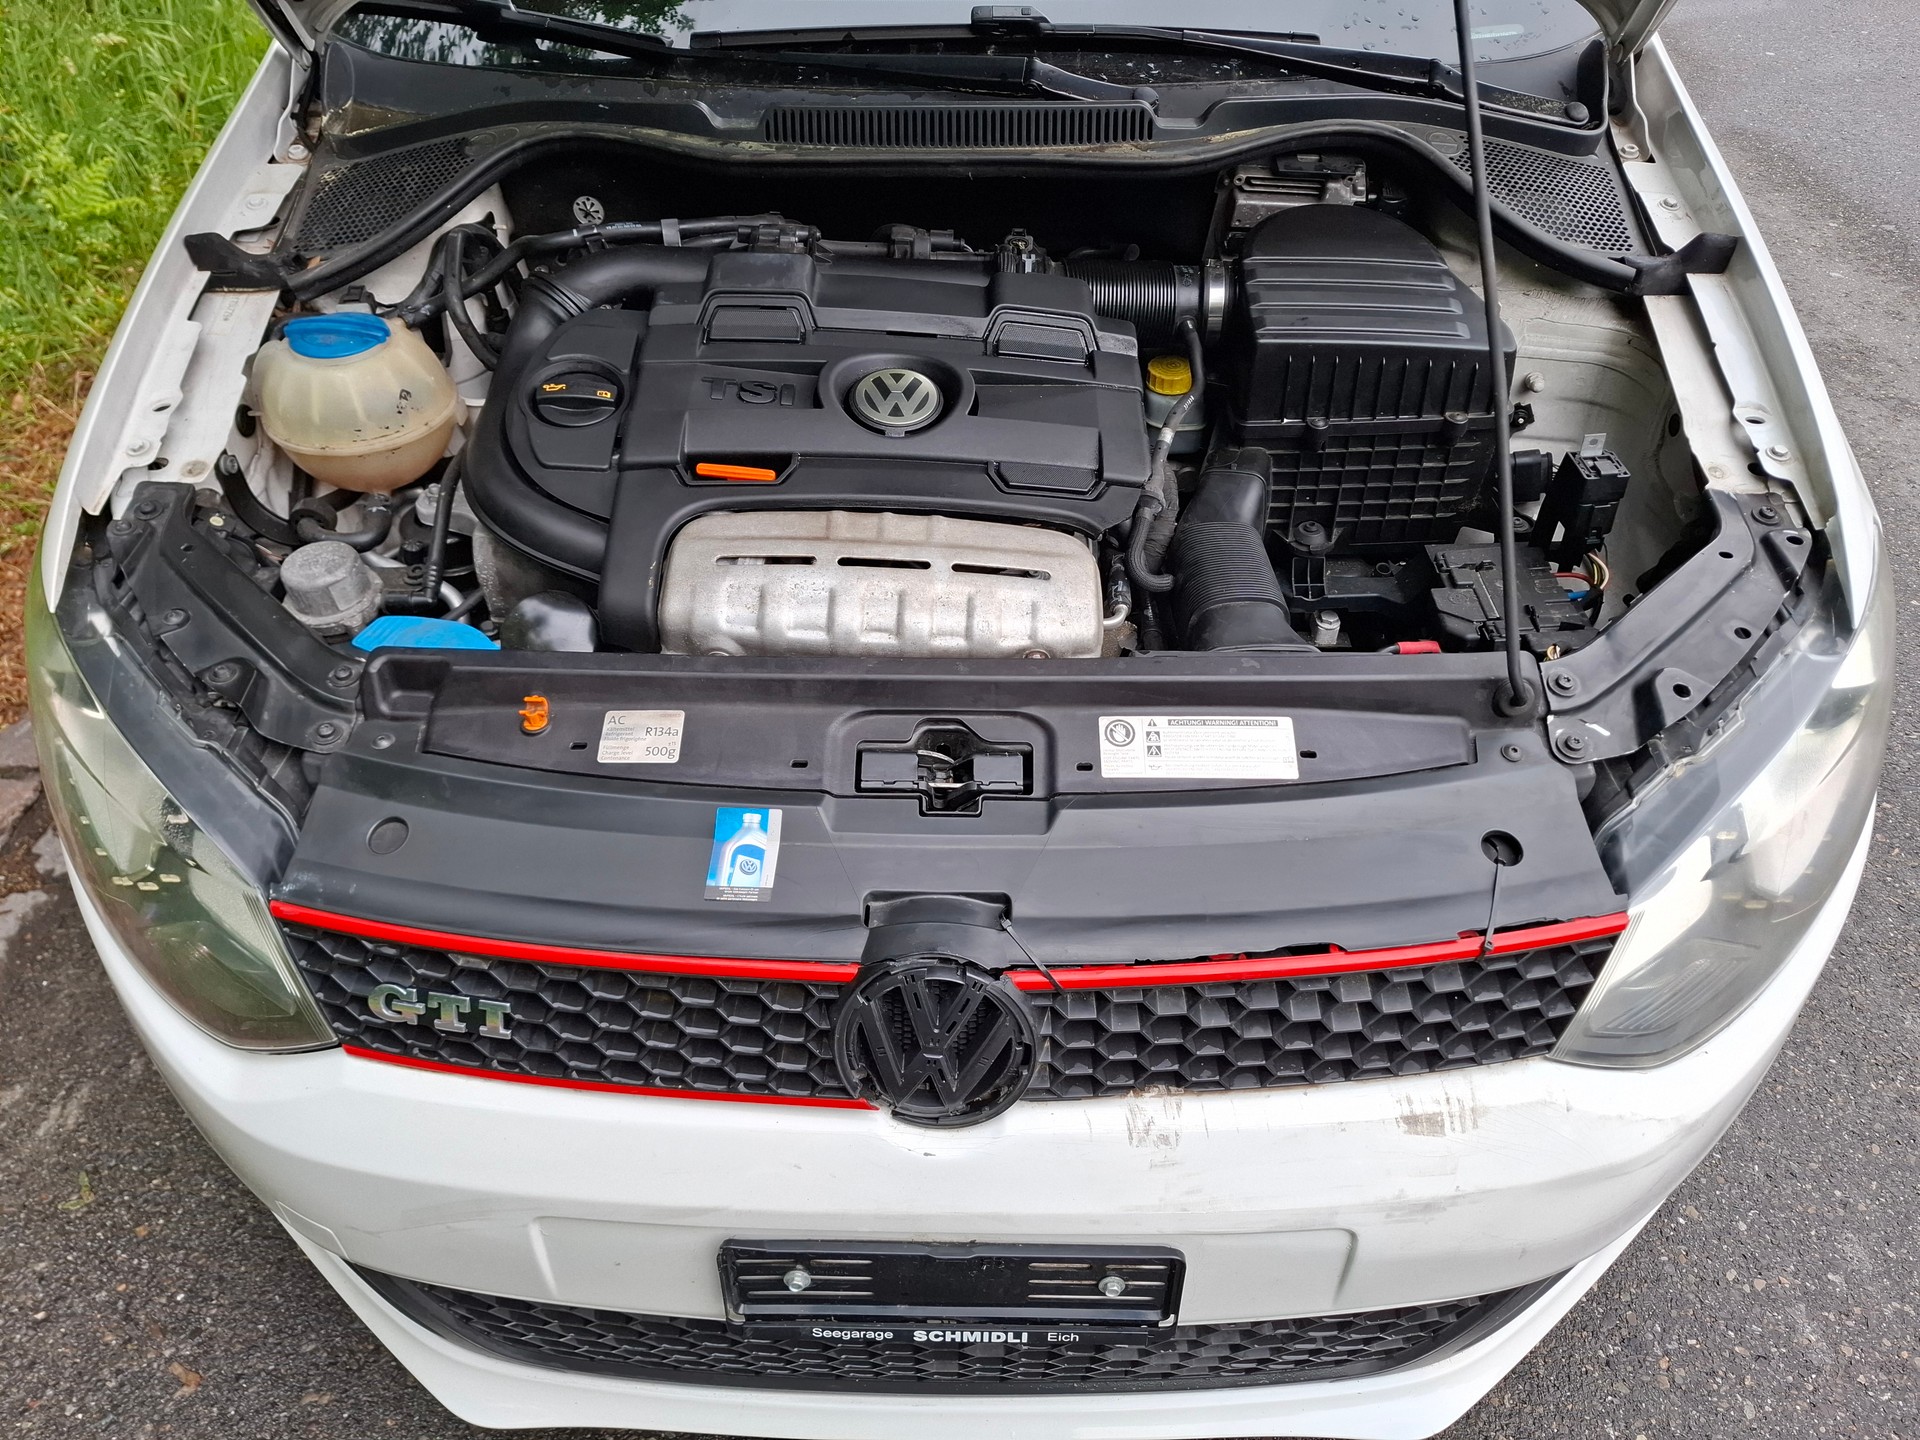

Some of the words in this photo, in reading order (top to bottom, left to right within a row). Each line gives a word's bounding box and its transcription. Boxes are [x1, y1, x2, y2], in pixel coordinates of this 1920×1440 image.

[701, 376, 796, 406] TSI
[608, 716, 626, 724] AC
[645, 726, 678, 736] R134a
[645, 746, 676, 759] 500g
[368, 983, 512, 1040] GTI
[812, 1327, 894, 1341] Seegarage
[913, 1330, 1028, 1343] SCHMIDLI
[1047, 1332, 1080, 1342] Eich
